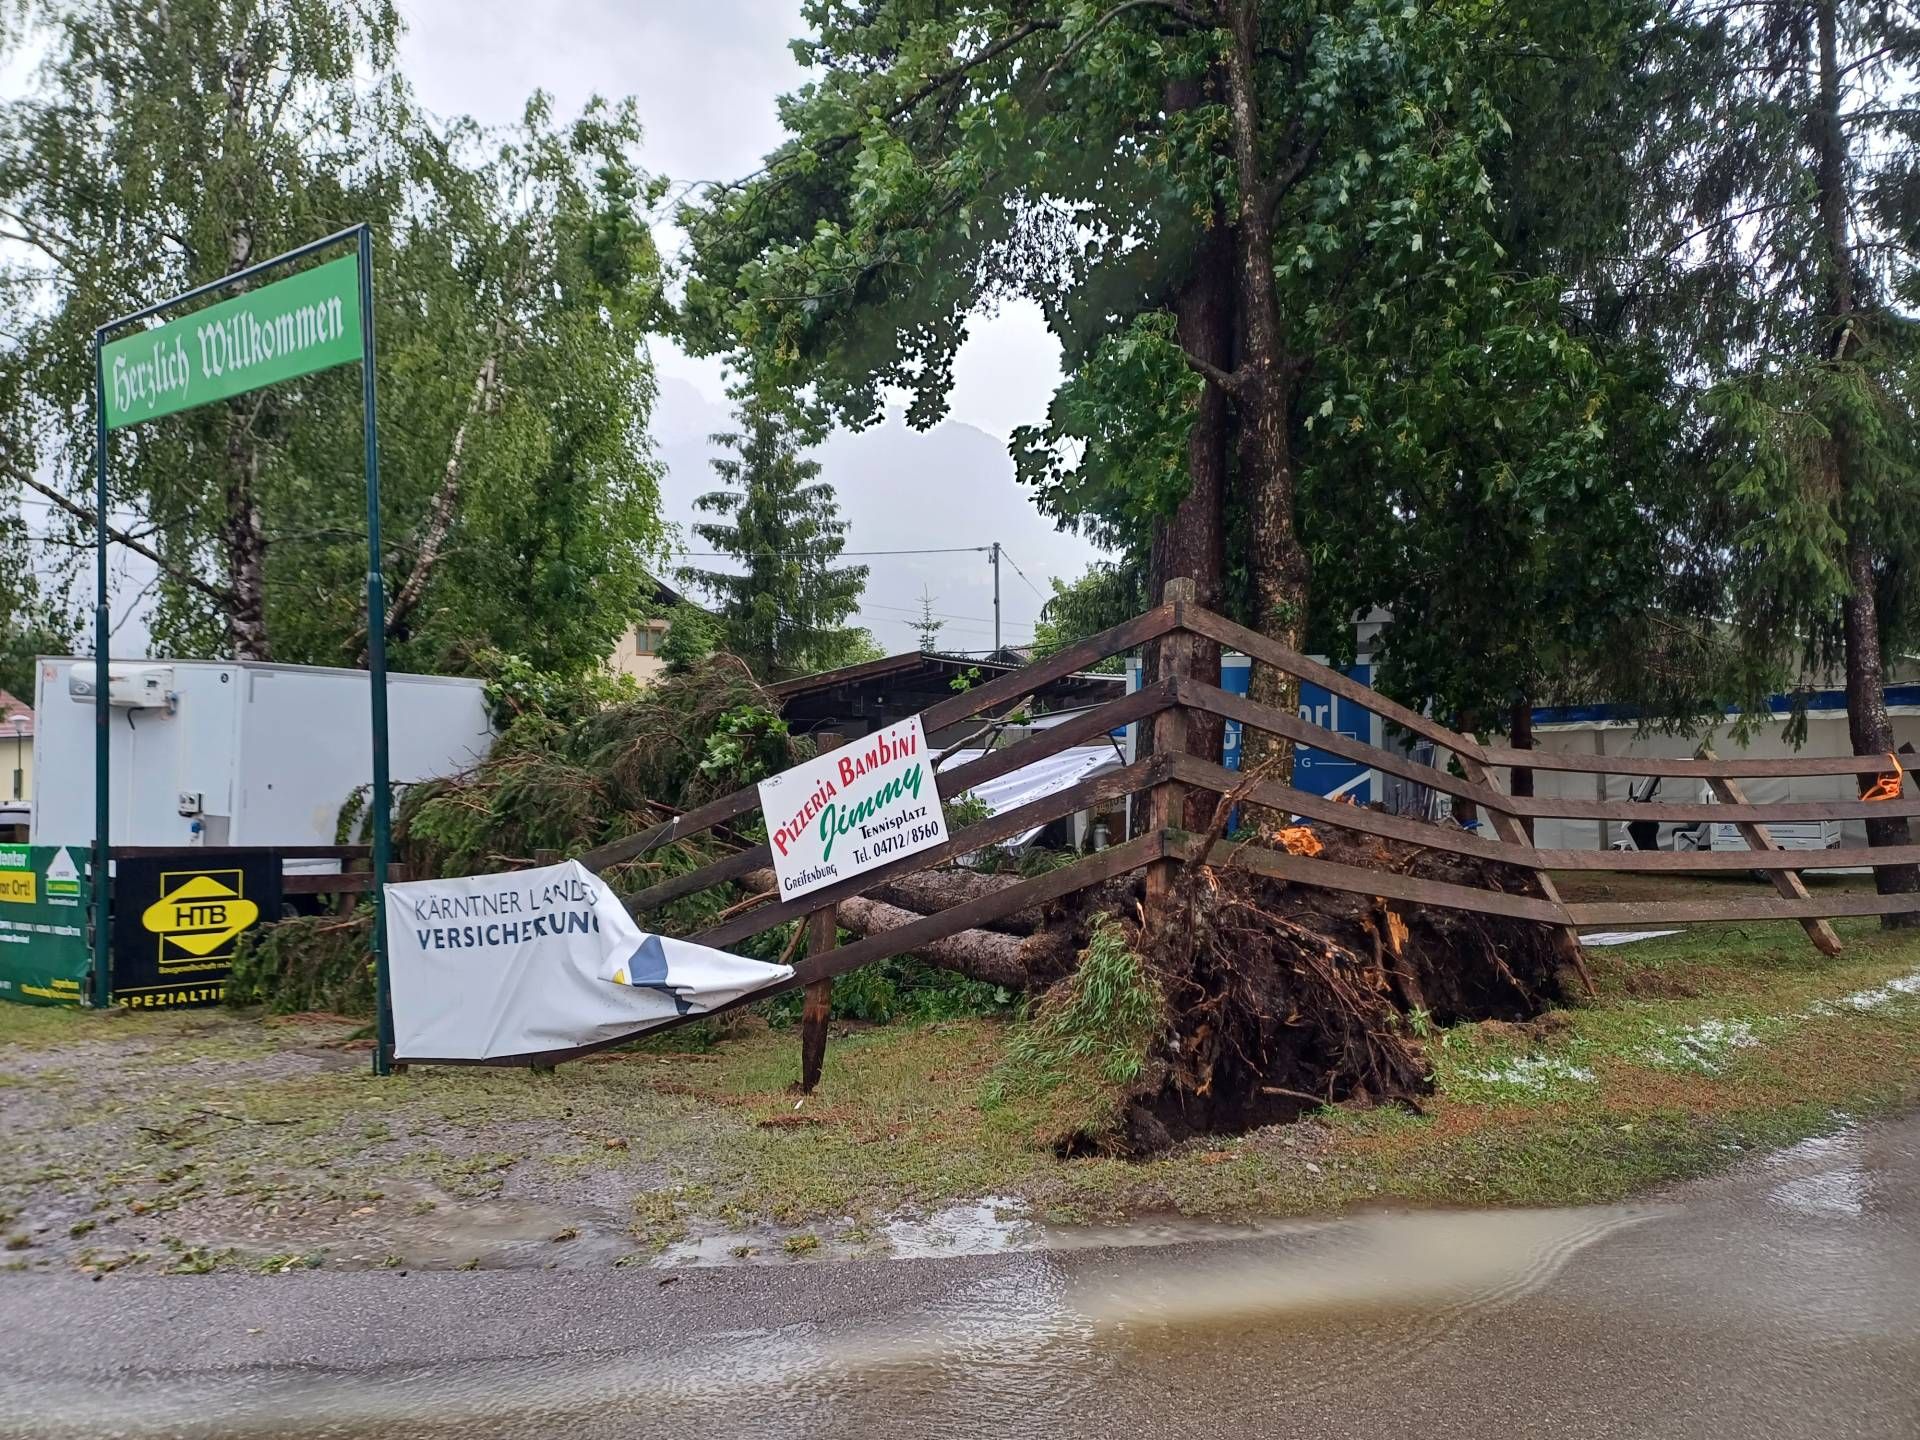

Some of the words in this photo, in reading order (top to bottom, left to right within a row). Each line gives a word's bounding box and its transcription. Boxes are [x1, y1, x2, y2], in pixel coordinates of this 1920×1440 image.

[112, 333, 190, 412] Herzlich
[197, 295, 344, 379] Willkommen
[819, 763, 923, 863] Jimmy
[853, 850, 872, 865] Tel.
[873, 820, 939, 858] 04712/8560
[175, 904, 228, 927] HTB
[415, 891, 522, 921] KÄRNTNER
